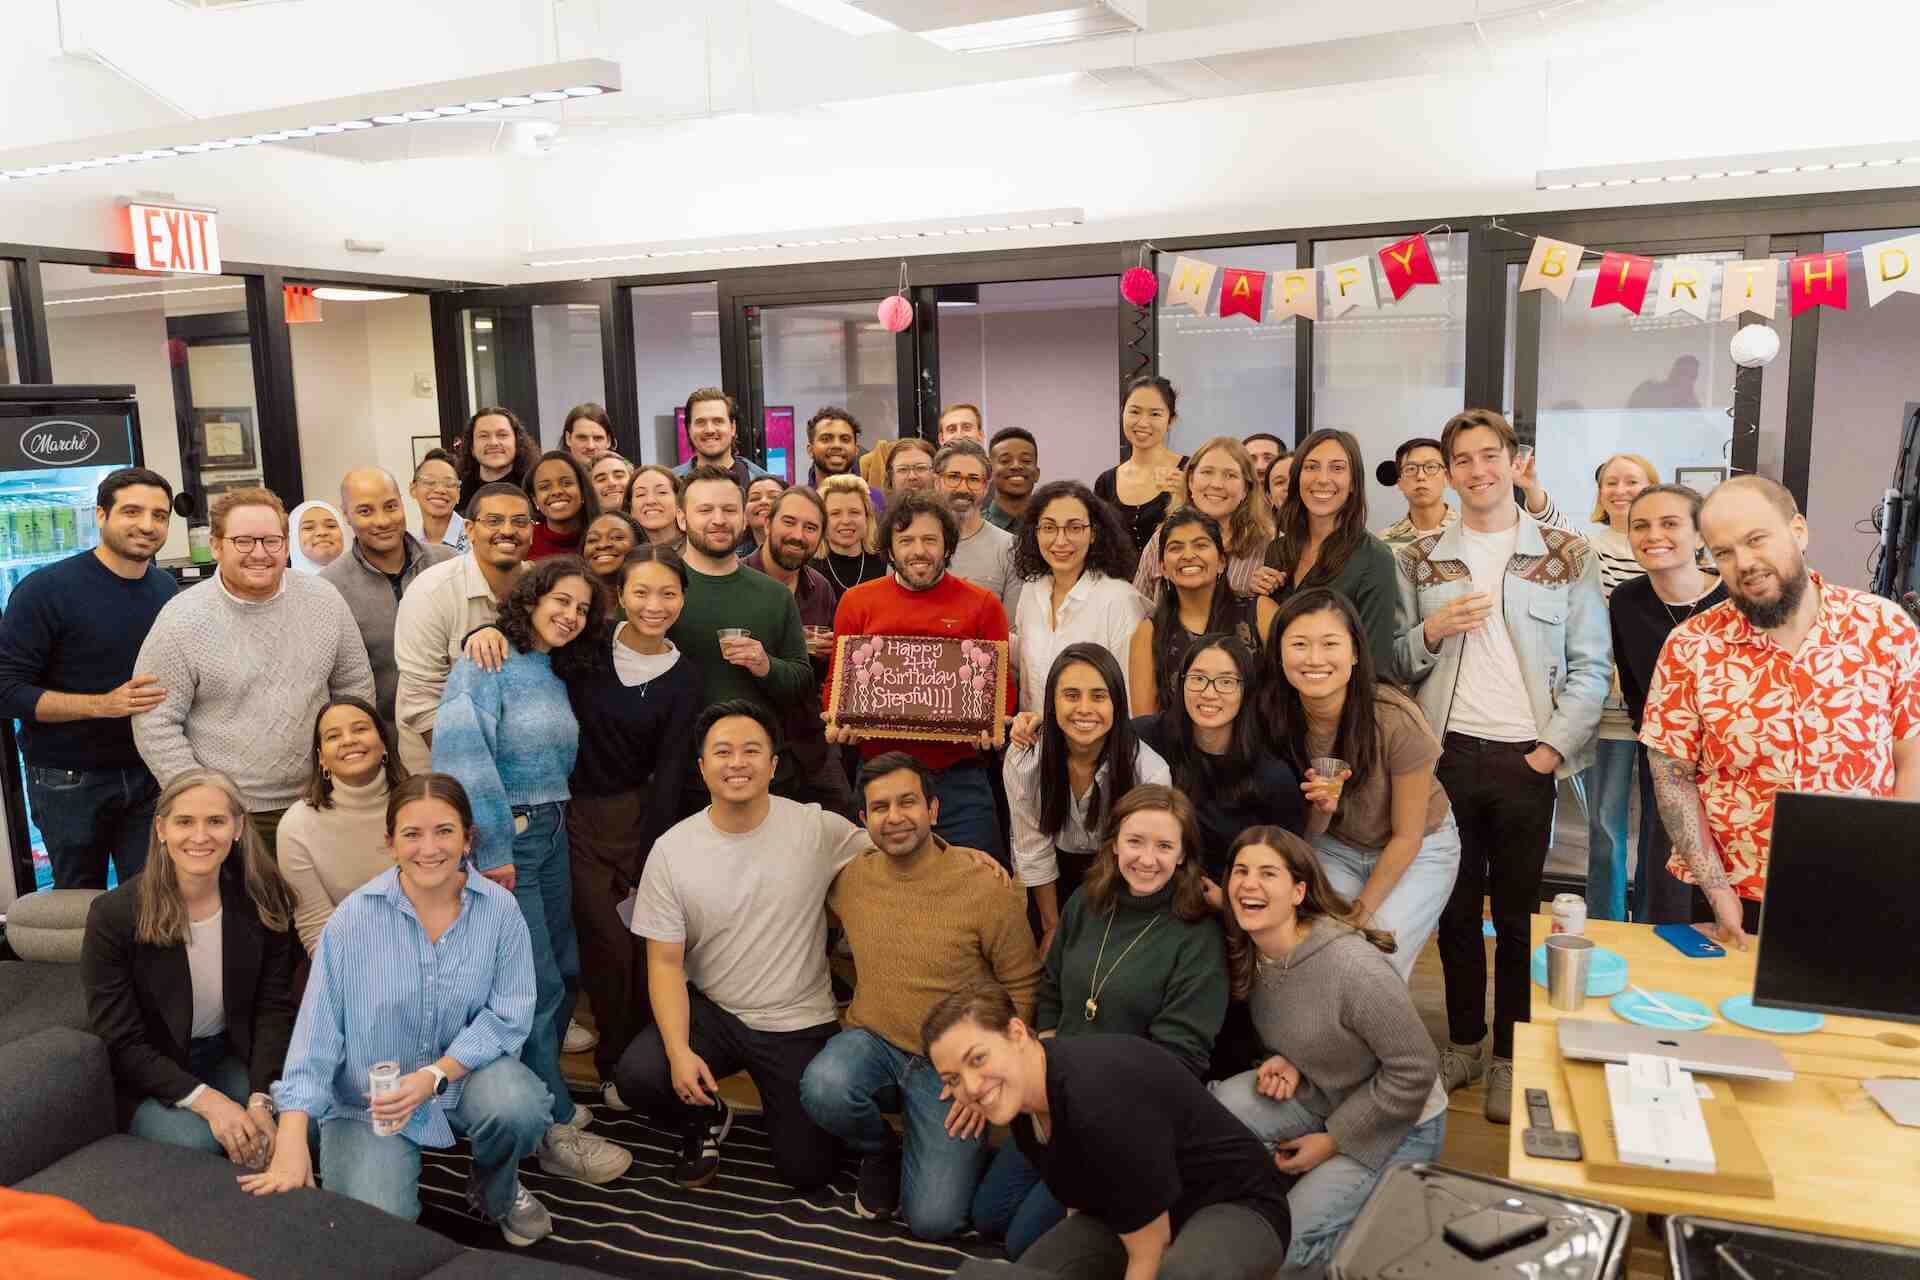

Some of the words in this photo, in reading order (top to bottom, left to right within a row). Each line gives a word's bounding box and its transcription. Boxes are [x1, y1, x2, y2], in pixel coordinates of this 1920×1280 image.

[143, 208, 209, 271] EXIT
[1539, 246, 1909, 298] BIRTHD
[887, 640, 943, 658] Happy
[903, 656, 937, 671] 4th
[883, 667, 957, 690] Birthday
[873, 686, 953, 714] Stepful!!!
